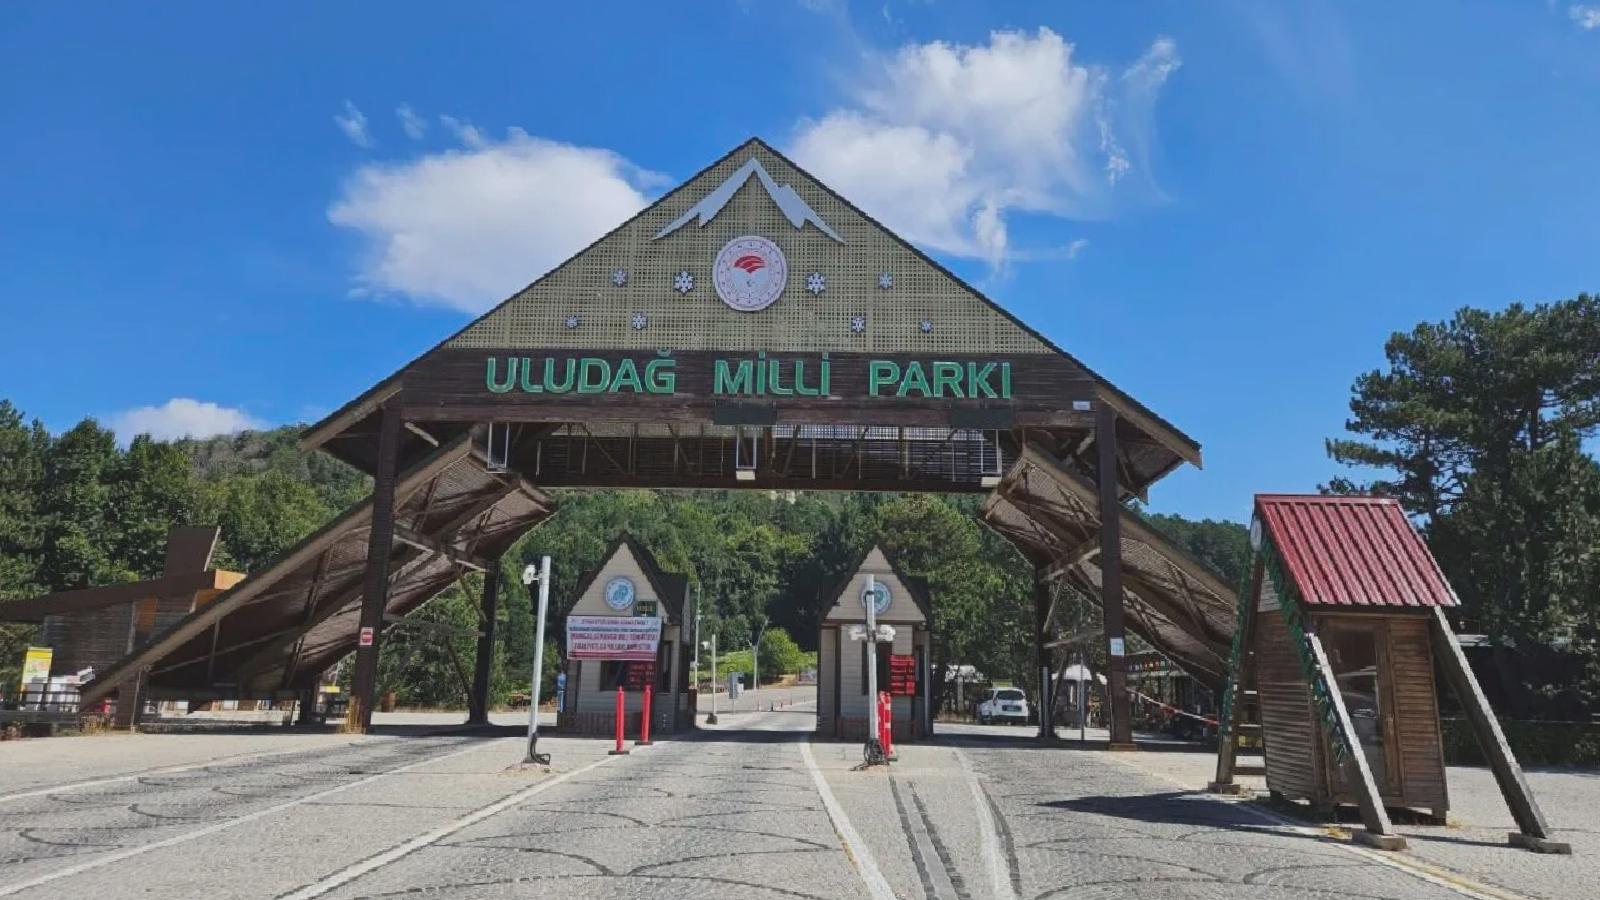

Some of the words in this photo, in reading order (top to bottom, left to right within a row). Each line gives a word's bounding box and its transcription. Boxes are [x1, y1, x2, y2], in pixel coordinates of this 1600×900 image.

[486, 349, 676, 394] ULUDAĞ
[714, 350, 831, 396] MİLLİ
[869, 360, 1012, 399] PARKI
